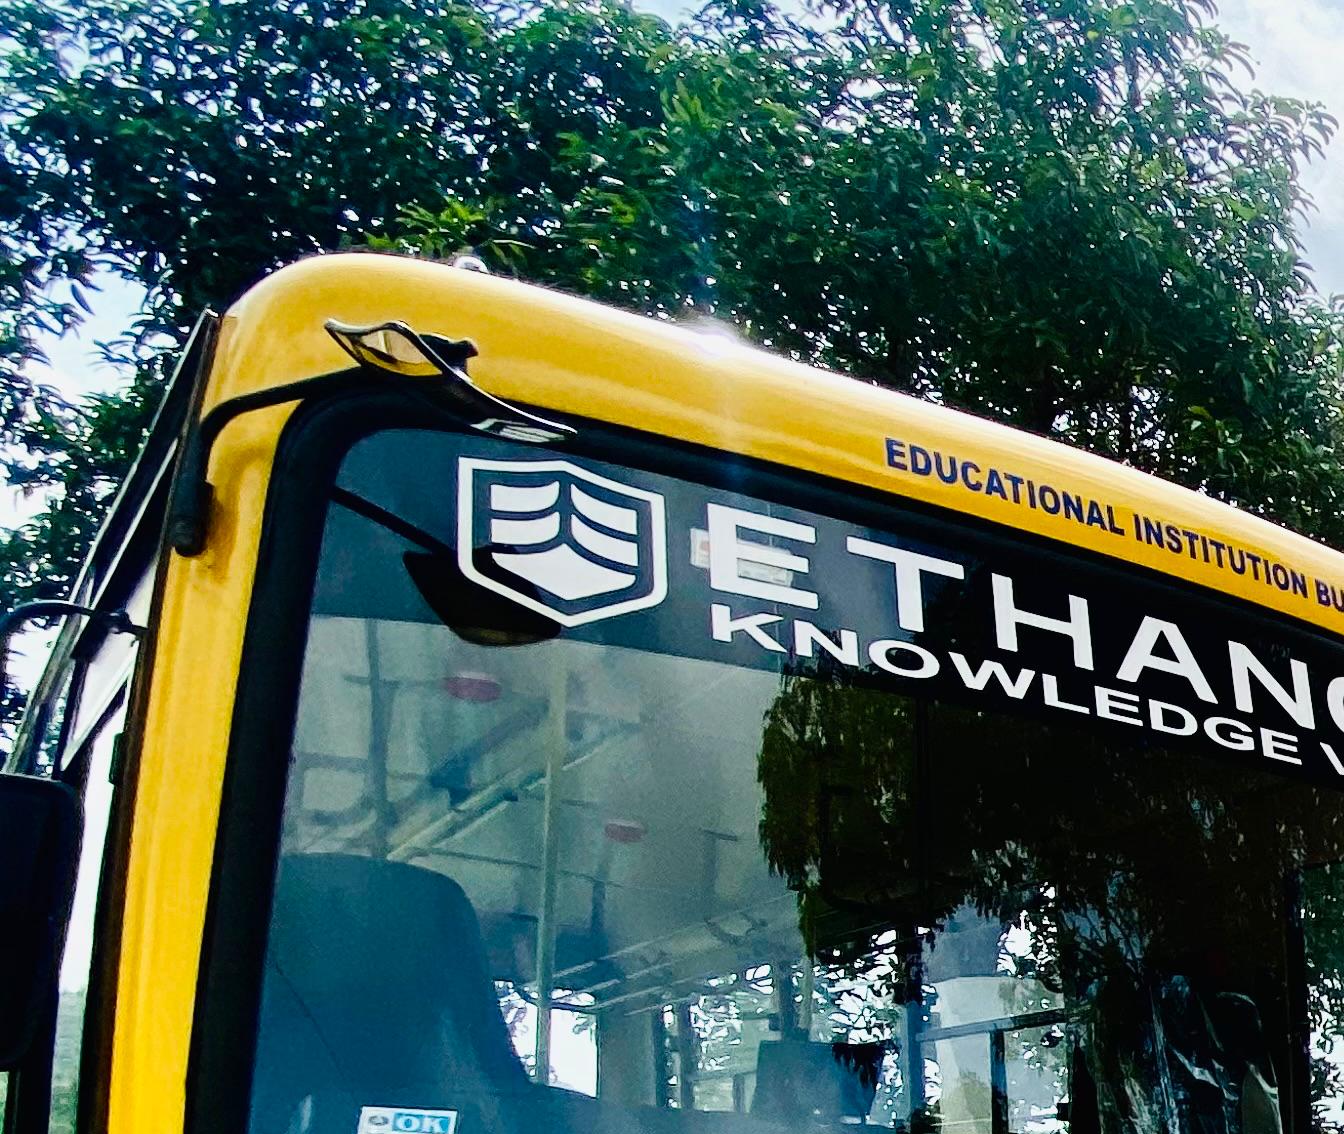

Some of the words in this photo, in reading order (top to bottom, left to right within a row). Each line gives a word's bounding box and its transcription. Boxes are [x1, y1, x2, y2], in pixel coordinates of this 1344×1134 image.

[885, 437, 1125, 536] EDUCATIONAL
[1133, 512, 1308, 599] INSTITUTION
[711, 603, 1303, 766] KNOWLEDGE
[396, 1115, 446, 1134] OK
